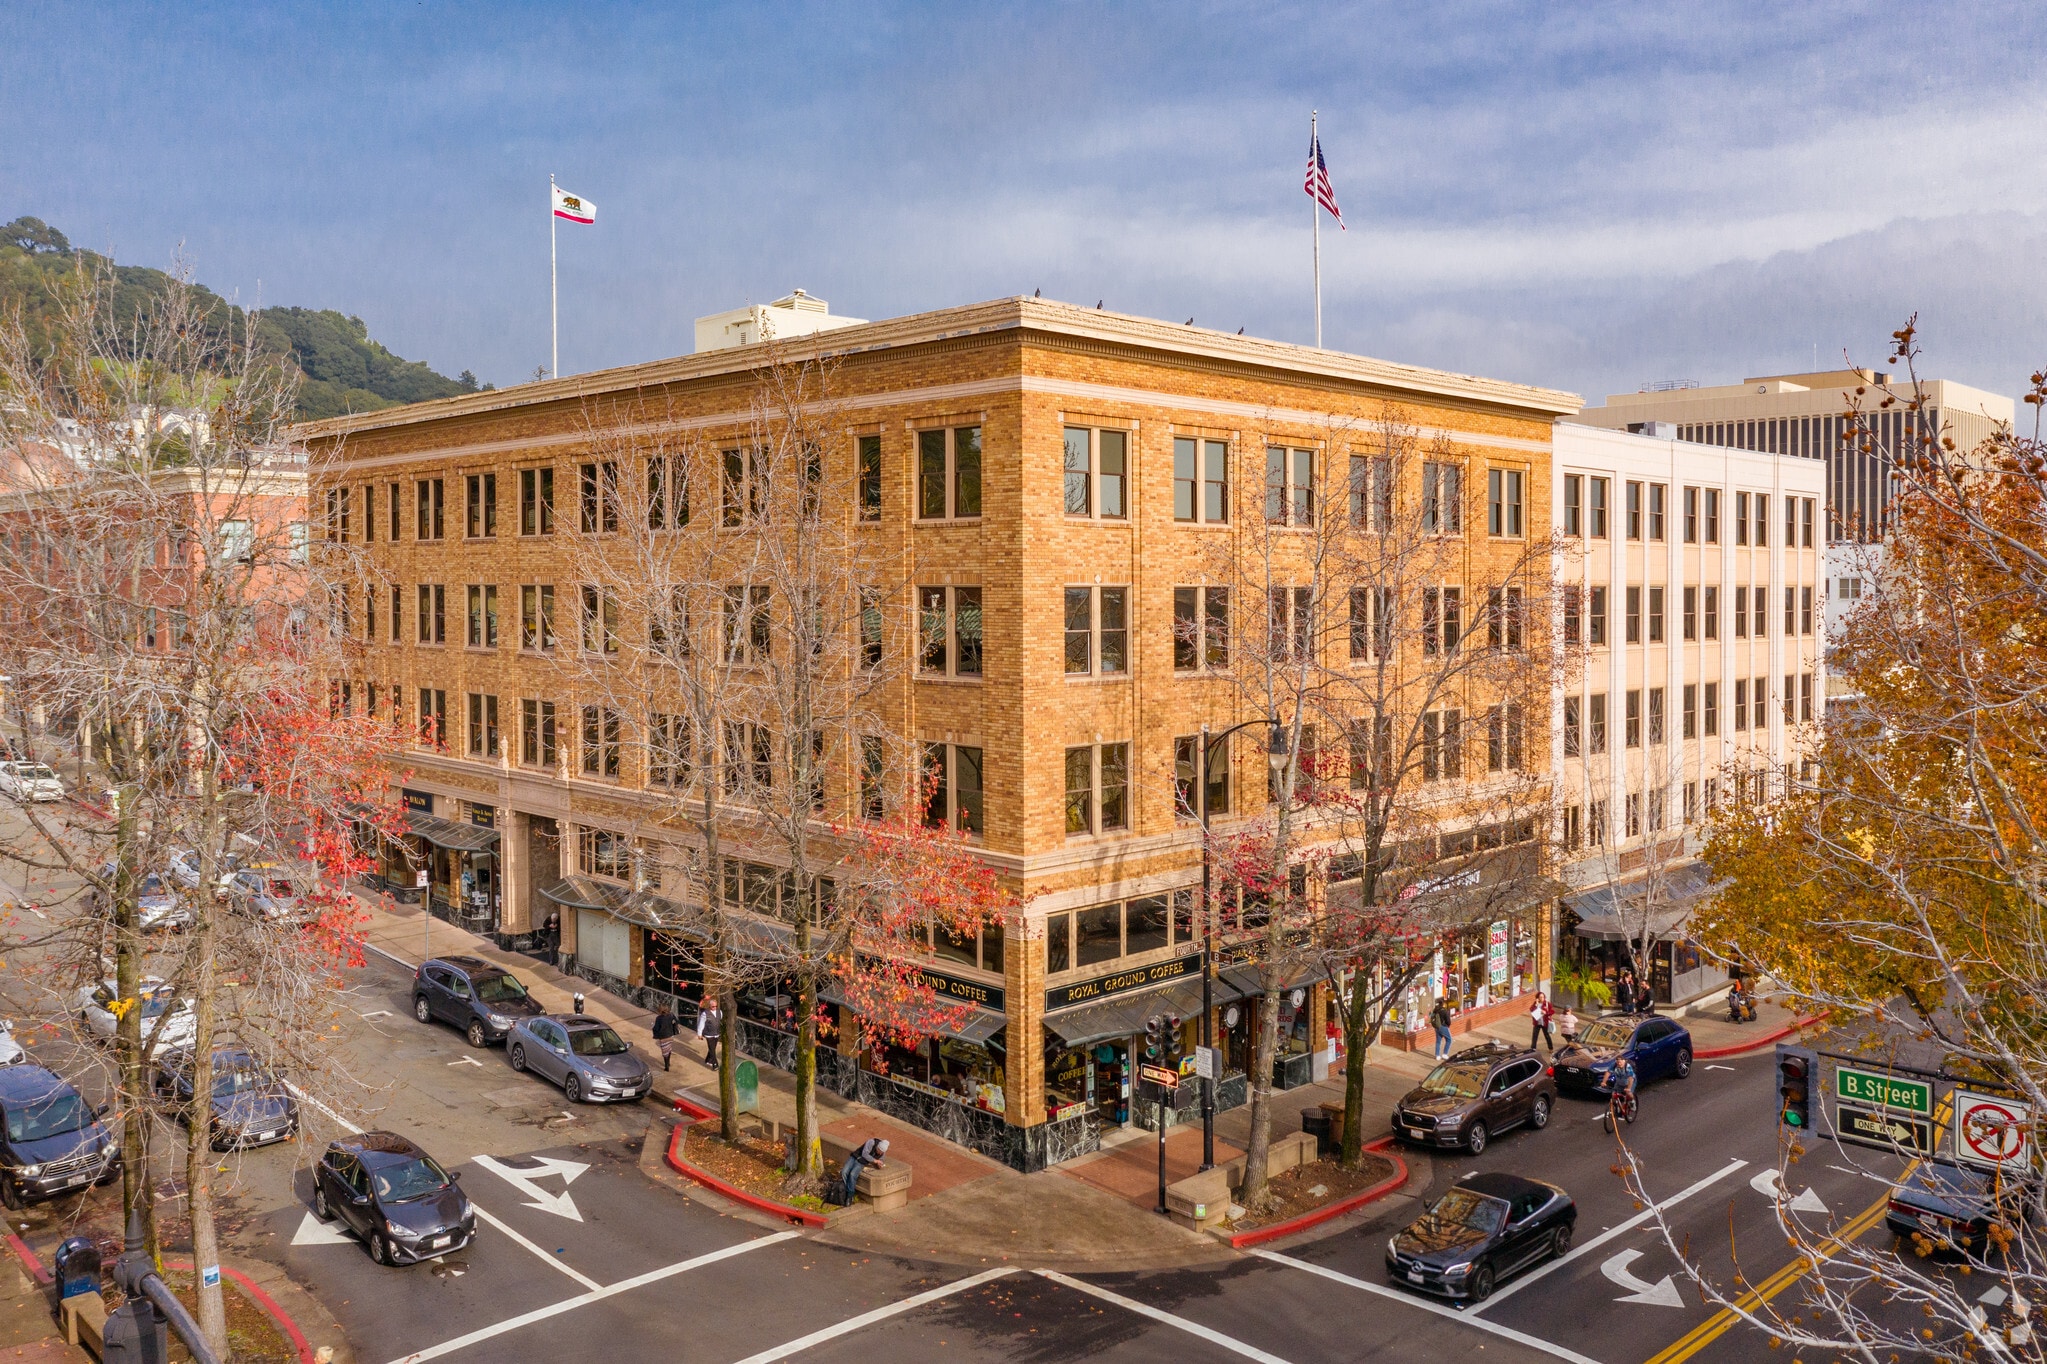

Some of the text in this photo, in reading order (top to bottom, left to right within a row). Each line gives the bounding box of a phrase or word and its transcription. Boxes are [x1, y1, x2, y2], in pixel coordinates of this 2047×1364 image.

[1176, 943, 1198, 957] FOURTH
[1214, 953, 1220, 961] B
[1068, 962, 1184, 1001] ROYAL GROUND COFFEE
[951, 982, 988, 1002] COFFEE
[1144, 1068, 1167, 1080] ONE WAY
[1847, 1076, 1918, 1106] B Street
[1858, 1120, 1897, 1135] ONE WAY
